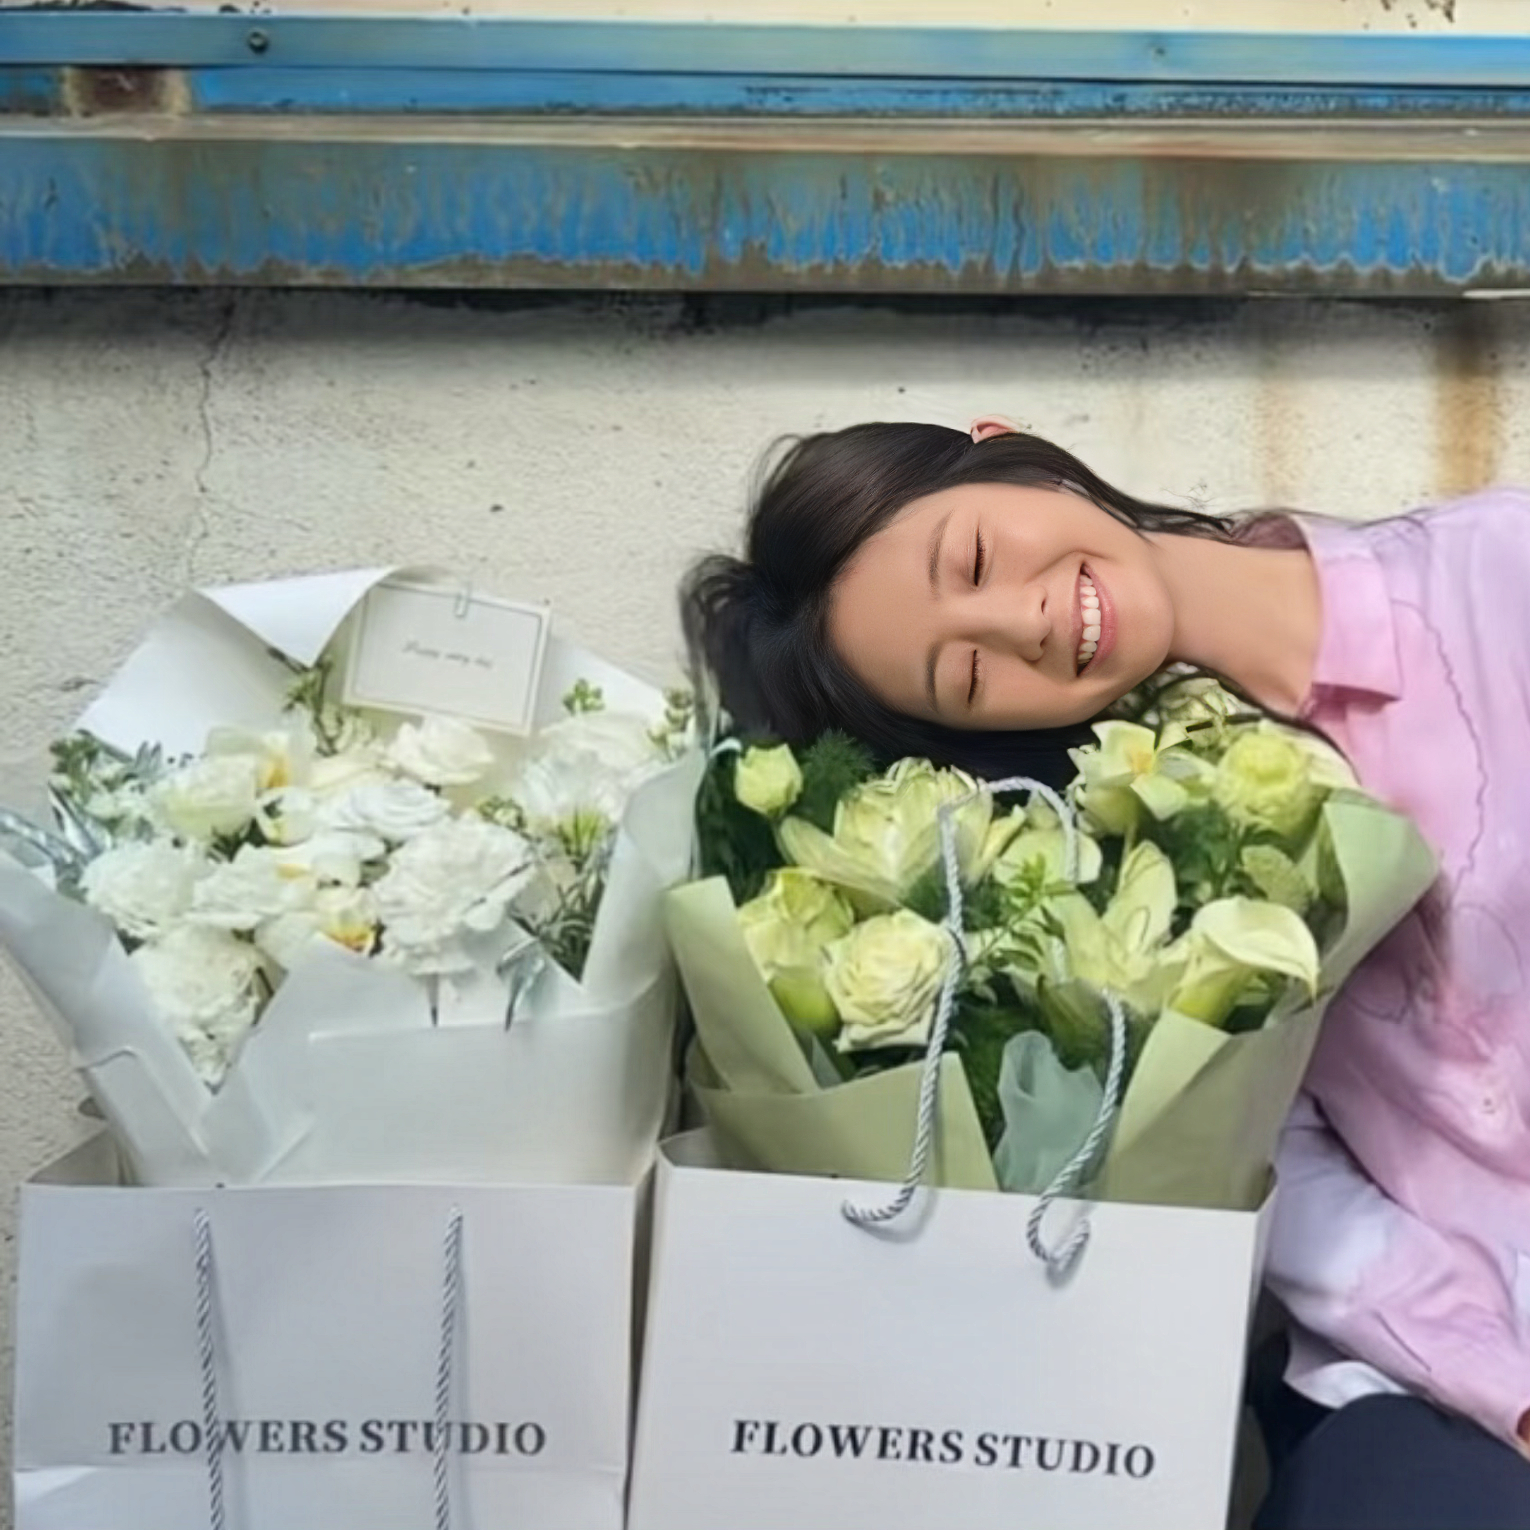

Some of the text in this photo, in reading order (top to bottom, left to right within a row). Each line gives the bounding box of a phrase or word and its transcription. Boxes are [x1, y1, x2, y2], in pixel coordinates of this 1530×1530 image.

[107, 1419, 547, 1456] FLOWERS STUDIO
[730, 1419, 1156, 1479] FLOWERS STUDIO
